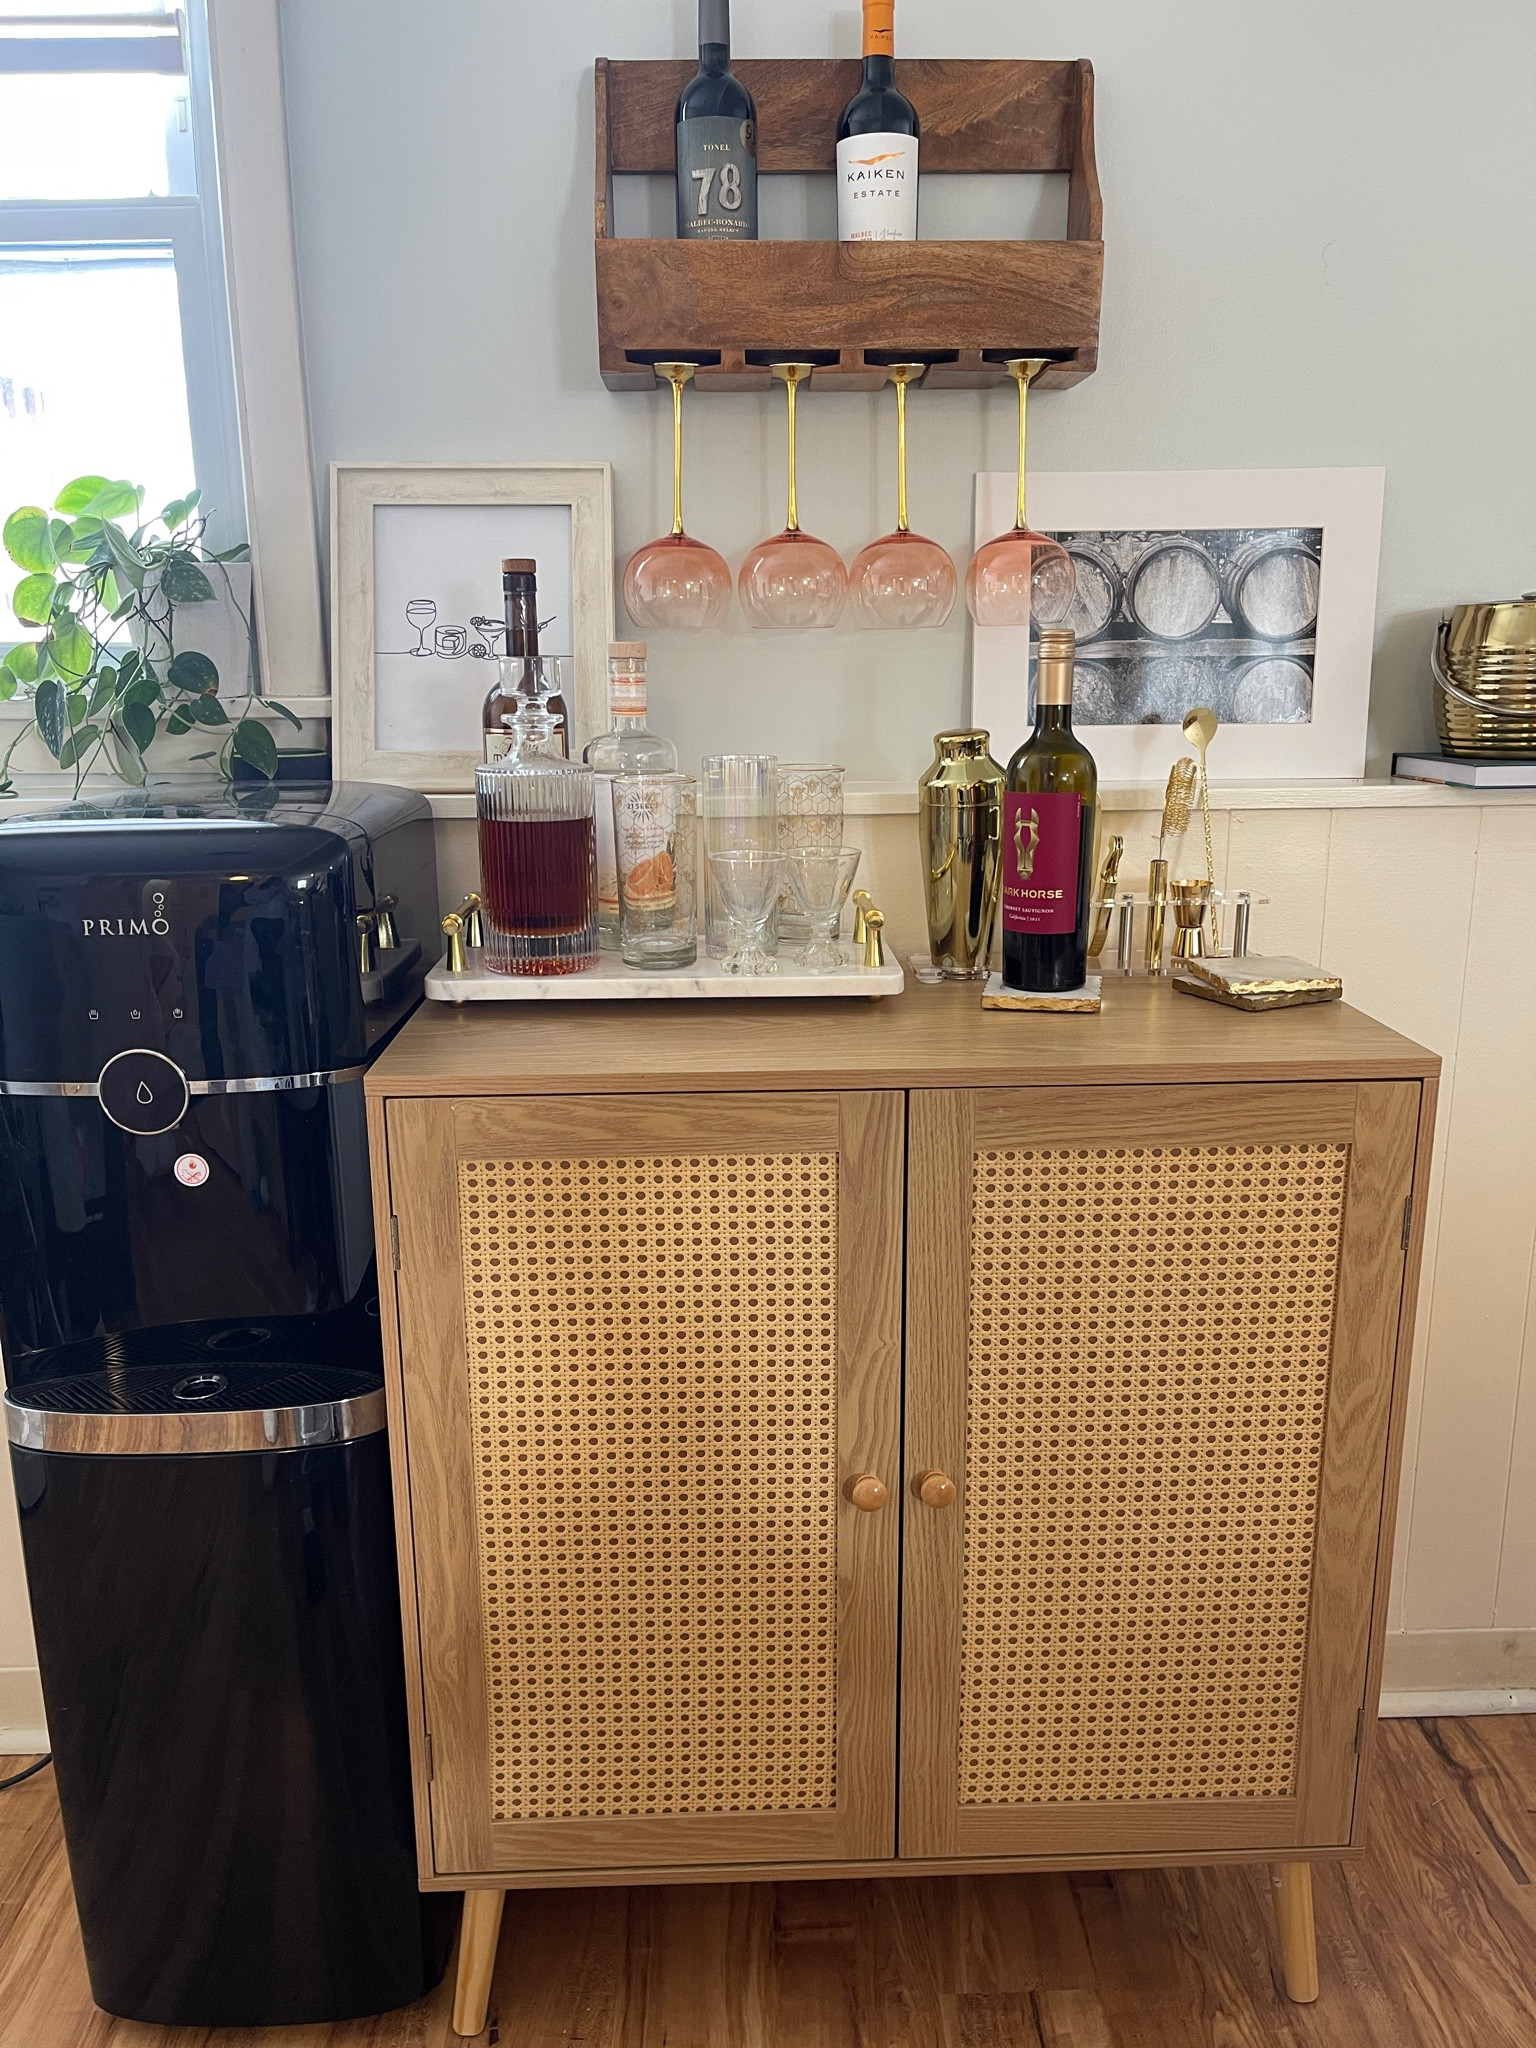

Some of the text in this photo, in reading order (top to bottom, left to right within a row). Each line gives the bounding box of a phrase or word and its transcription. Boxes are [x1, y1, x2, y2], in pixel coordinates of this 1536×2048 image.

[847, 169, 905, 182] KAIKEN
[692, 162, 742, 216] 78
[853, 190, 901, 199] ESTATE
[850, 230, 873, 239] MALBEC
[1003, 886, 1064, 899] ARK HORSE
[82, 918, 169, 936] PRIMO
